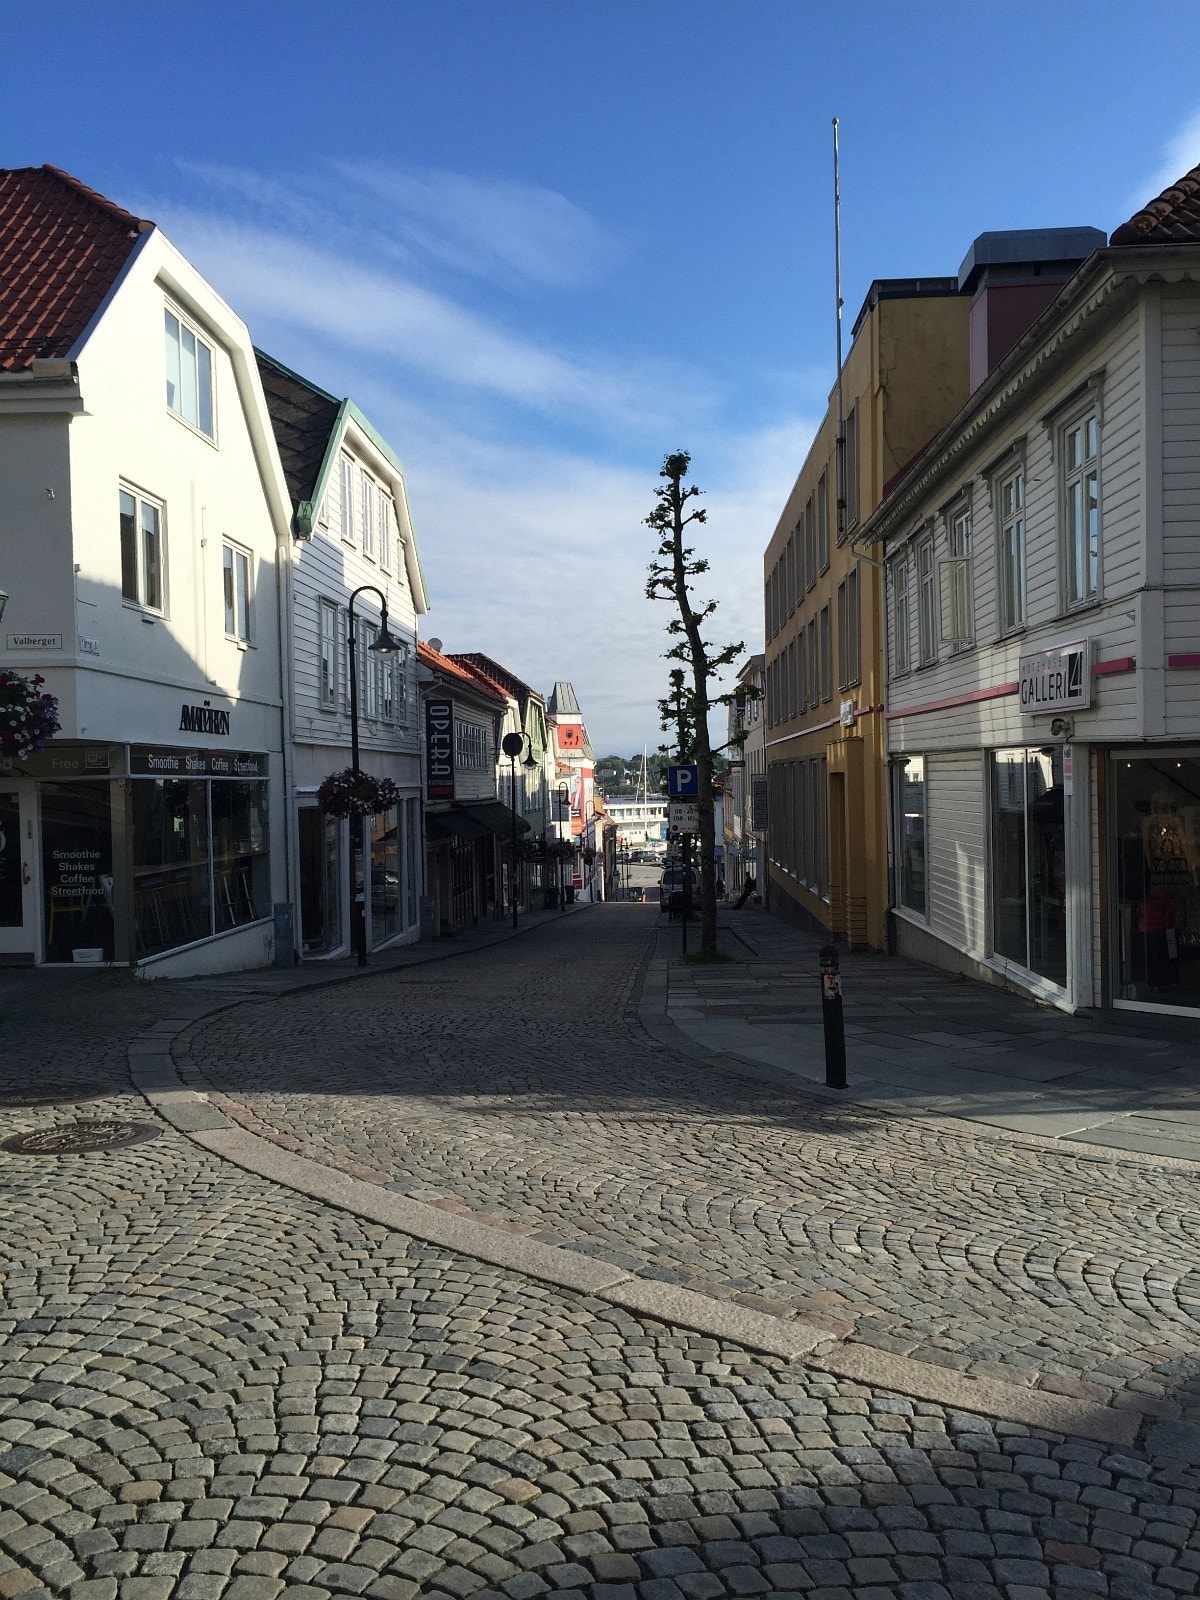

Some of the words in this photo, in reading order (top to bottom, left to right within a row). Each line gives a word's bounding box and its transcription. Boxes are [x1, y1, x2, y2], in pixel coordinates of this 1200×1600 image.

[13, 637, 56, 646] Valberget
[1021, 670, 1067, 705] GALLERI
[429, 705, 451, 775] OPERA
[52, 758, 79, 769] Free
[148, 753, 179, 770] Smoothie
[185, 756, 206, 771] Shakes
[211, 757, 229, 771] Coffee
[676, 769, 692, 792] P
[52, 849, 101, 859] Smoothie
[58, 861, 96, 871] Shakes
[60, 874, 94, 883] Coffee
[51, 886, 105, 896] Streetfood
